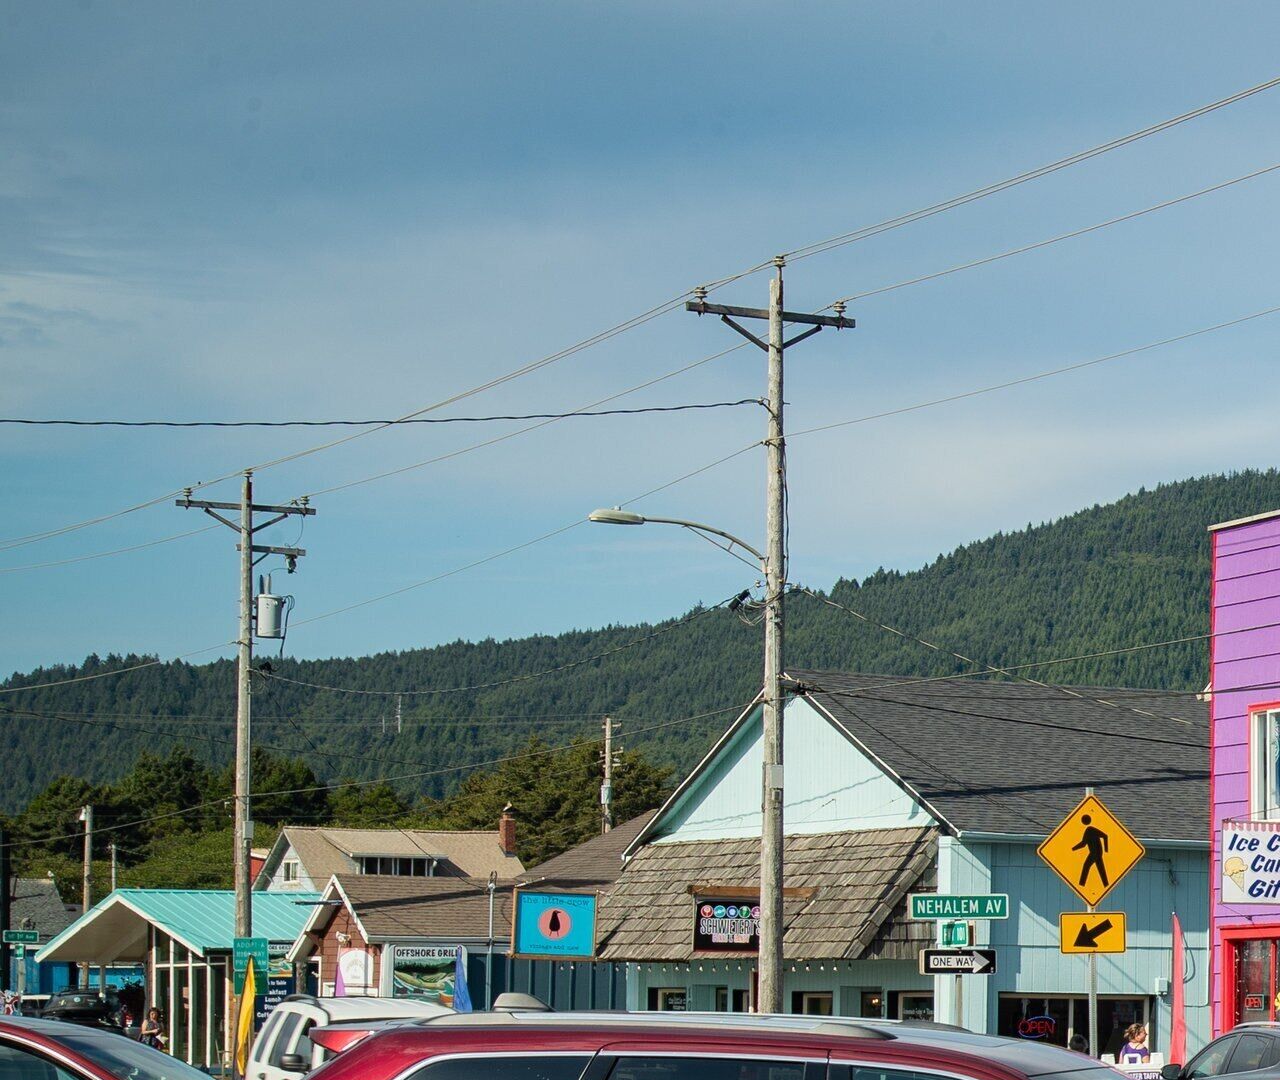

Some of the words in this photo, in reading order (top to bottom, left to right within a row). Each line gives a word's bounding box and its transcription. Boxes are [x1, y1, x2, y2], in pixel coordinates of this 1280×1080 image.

[1228, 833, 1260, 851] Ice
[522, 896, 539, 904] the
[917, 900, 979, 914] NEHALEM
[985, 900, 1002, 914] AV
[396, 948, 436, 957] OFFSHORE
[932, 957, 953, 967] ONE
[955, 957, 975, 967] WAY
[1245, 997, 1263, 1008] OPEN
[1019, 1019, 1056, 1034] OPEN
[1143, 1072, 1160, 1080] TAFFY
